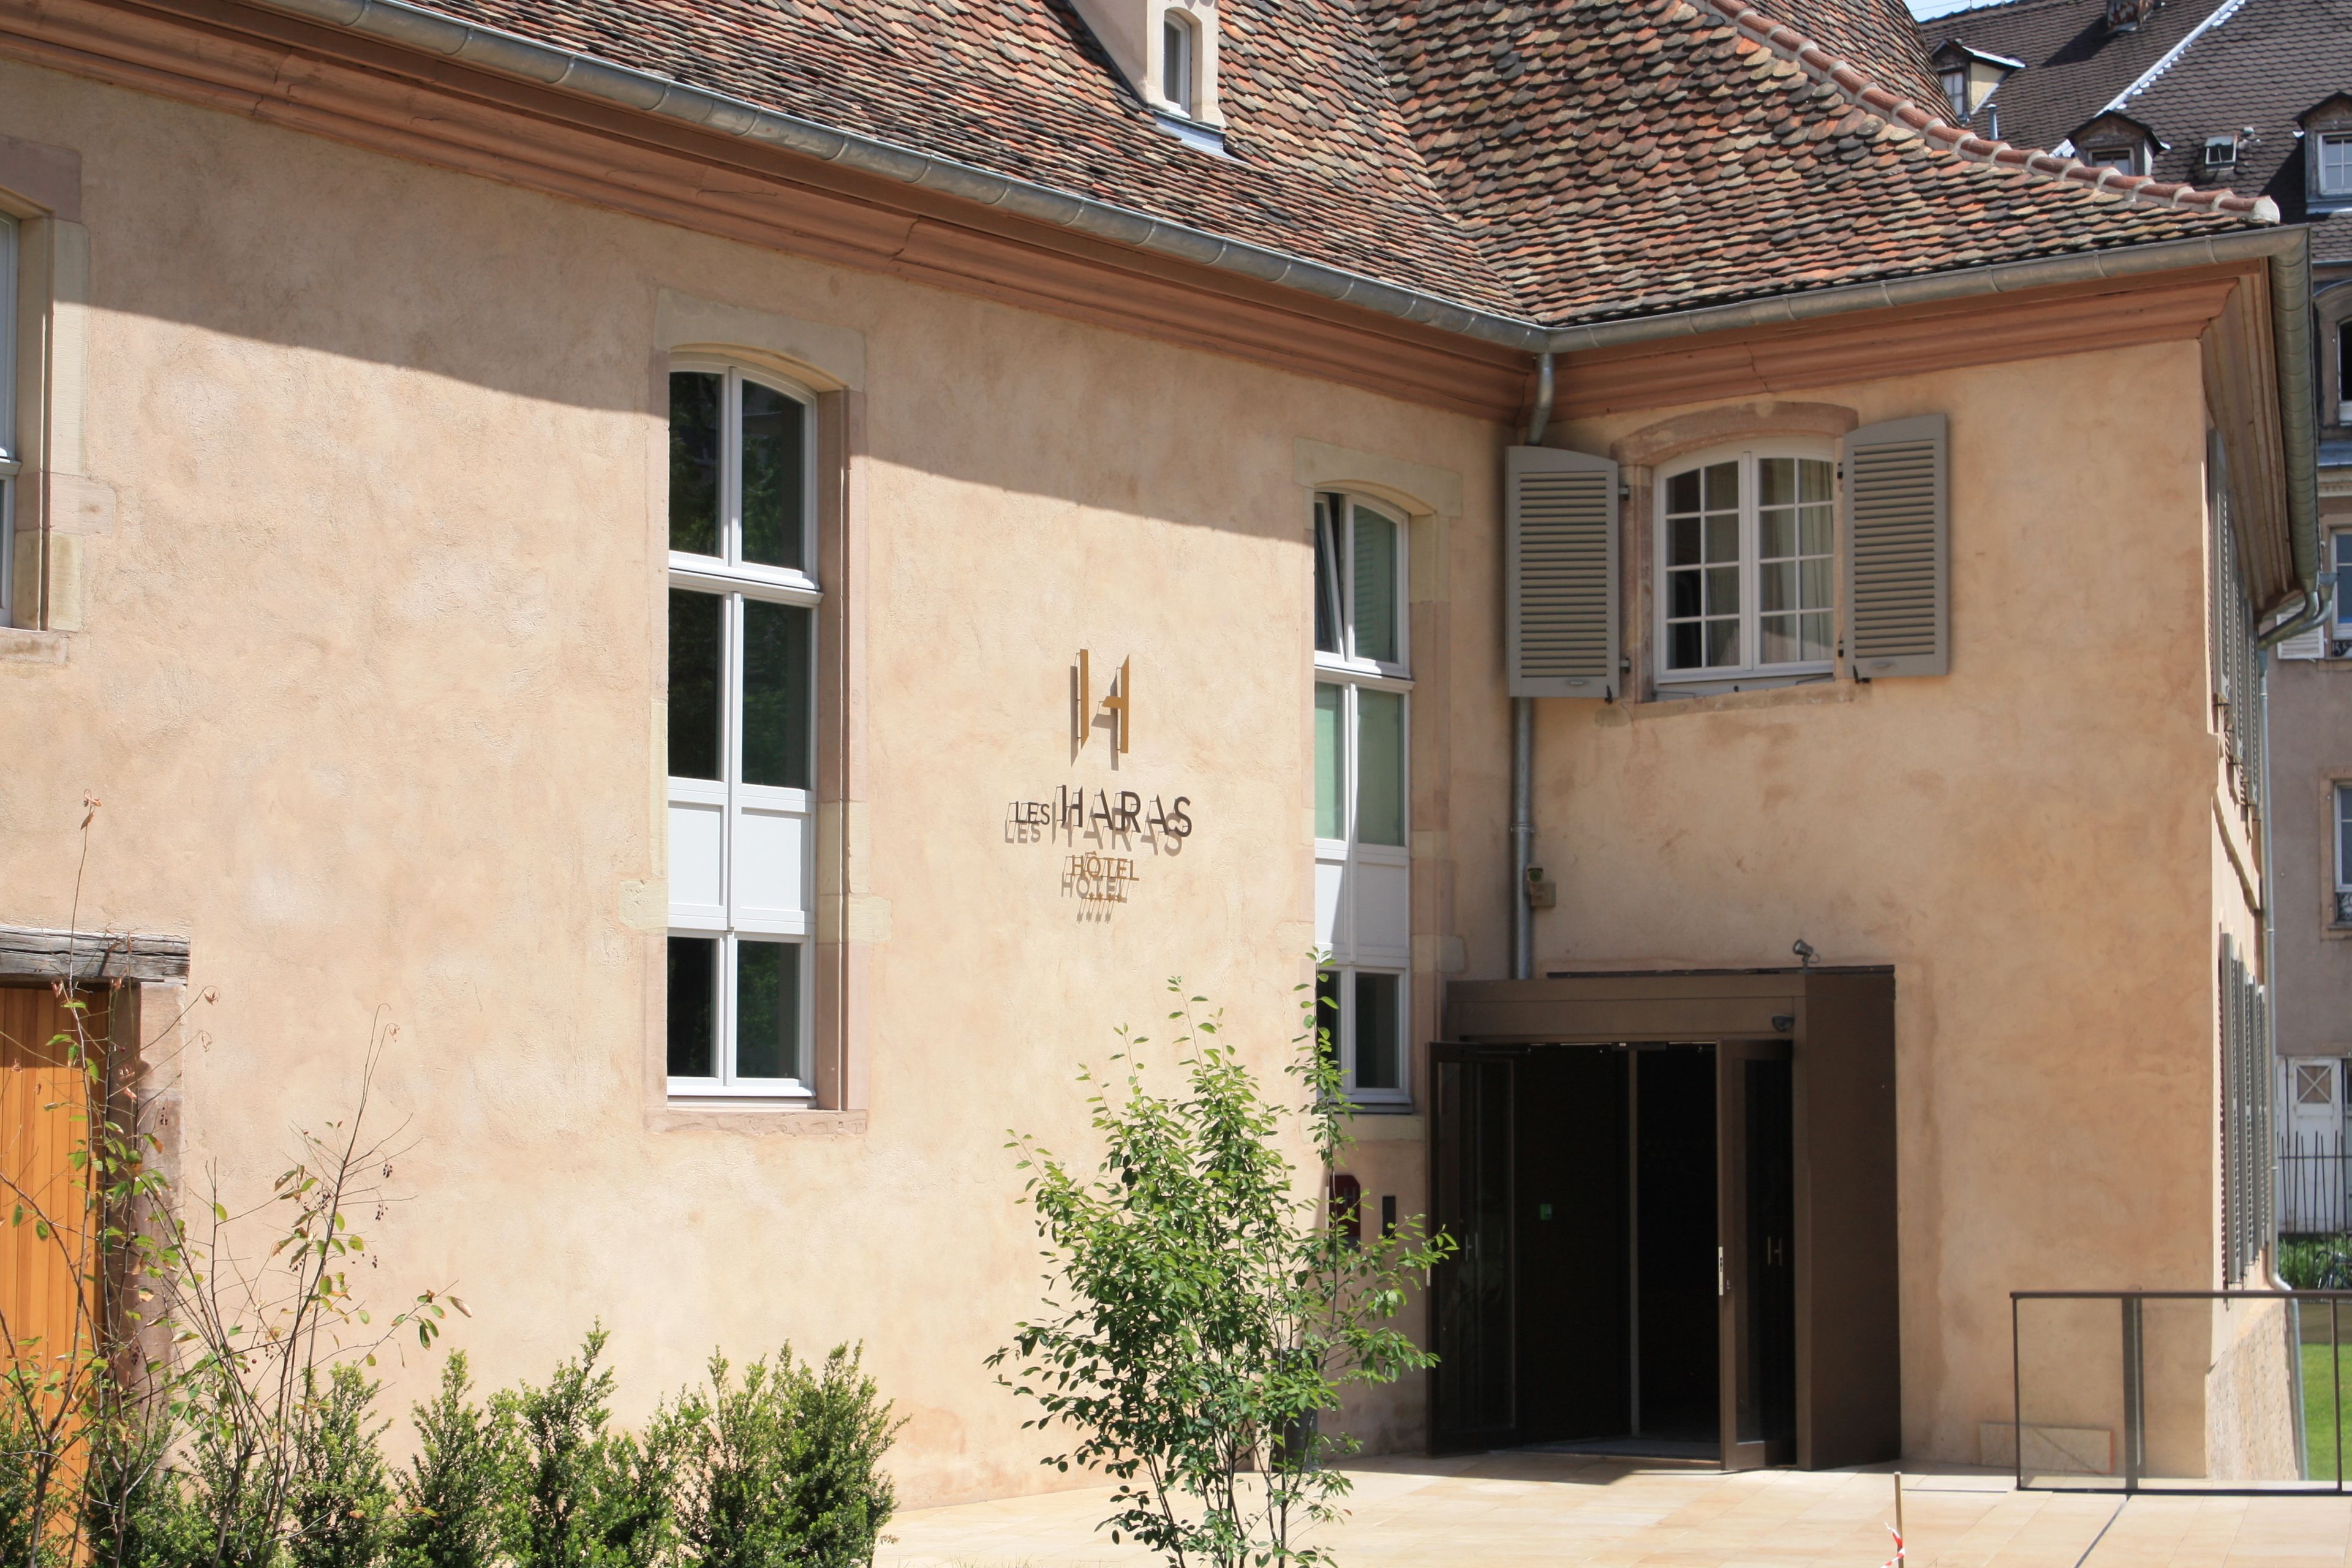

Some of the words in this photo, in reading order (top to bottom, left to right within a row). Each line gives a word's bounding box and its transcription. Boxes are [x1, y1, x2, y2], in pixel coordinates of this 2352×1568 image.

[1016, 801, 1050, 825] LES
[1062, 785, 1192, 837] HARAS
[1072, 851, 1139, 881] HÔTEL
